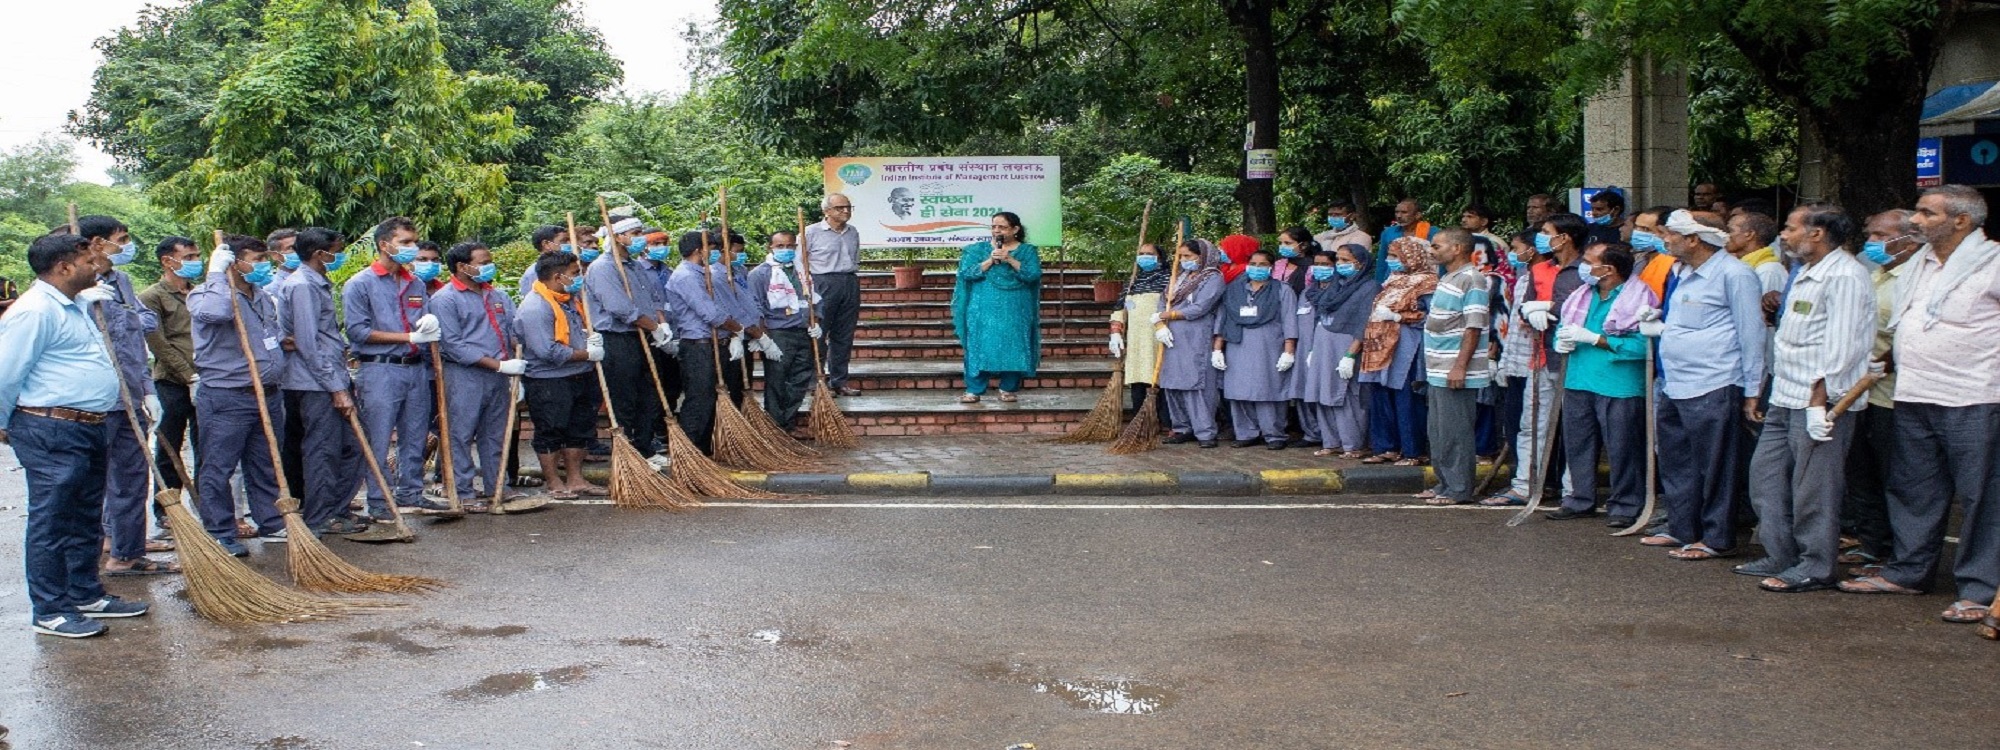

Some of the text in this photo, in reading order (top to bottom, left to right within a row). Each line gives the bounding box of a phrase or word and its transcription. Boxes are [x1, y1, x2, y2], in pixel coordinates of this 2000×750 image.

[882, 161, 1044, 172] भारतीय प्रबंध संस्थान लखनऊ
[881, 174, 907, 182] Indian
[908, 173, 942, 181] Institute
[955, 173, 1009, 181] Management
[919, 194, 974, 204] स्वच्छता
[919, 205, 935, 218] ही
[940, 205, 969, 217] सेवा
